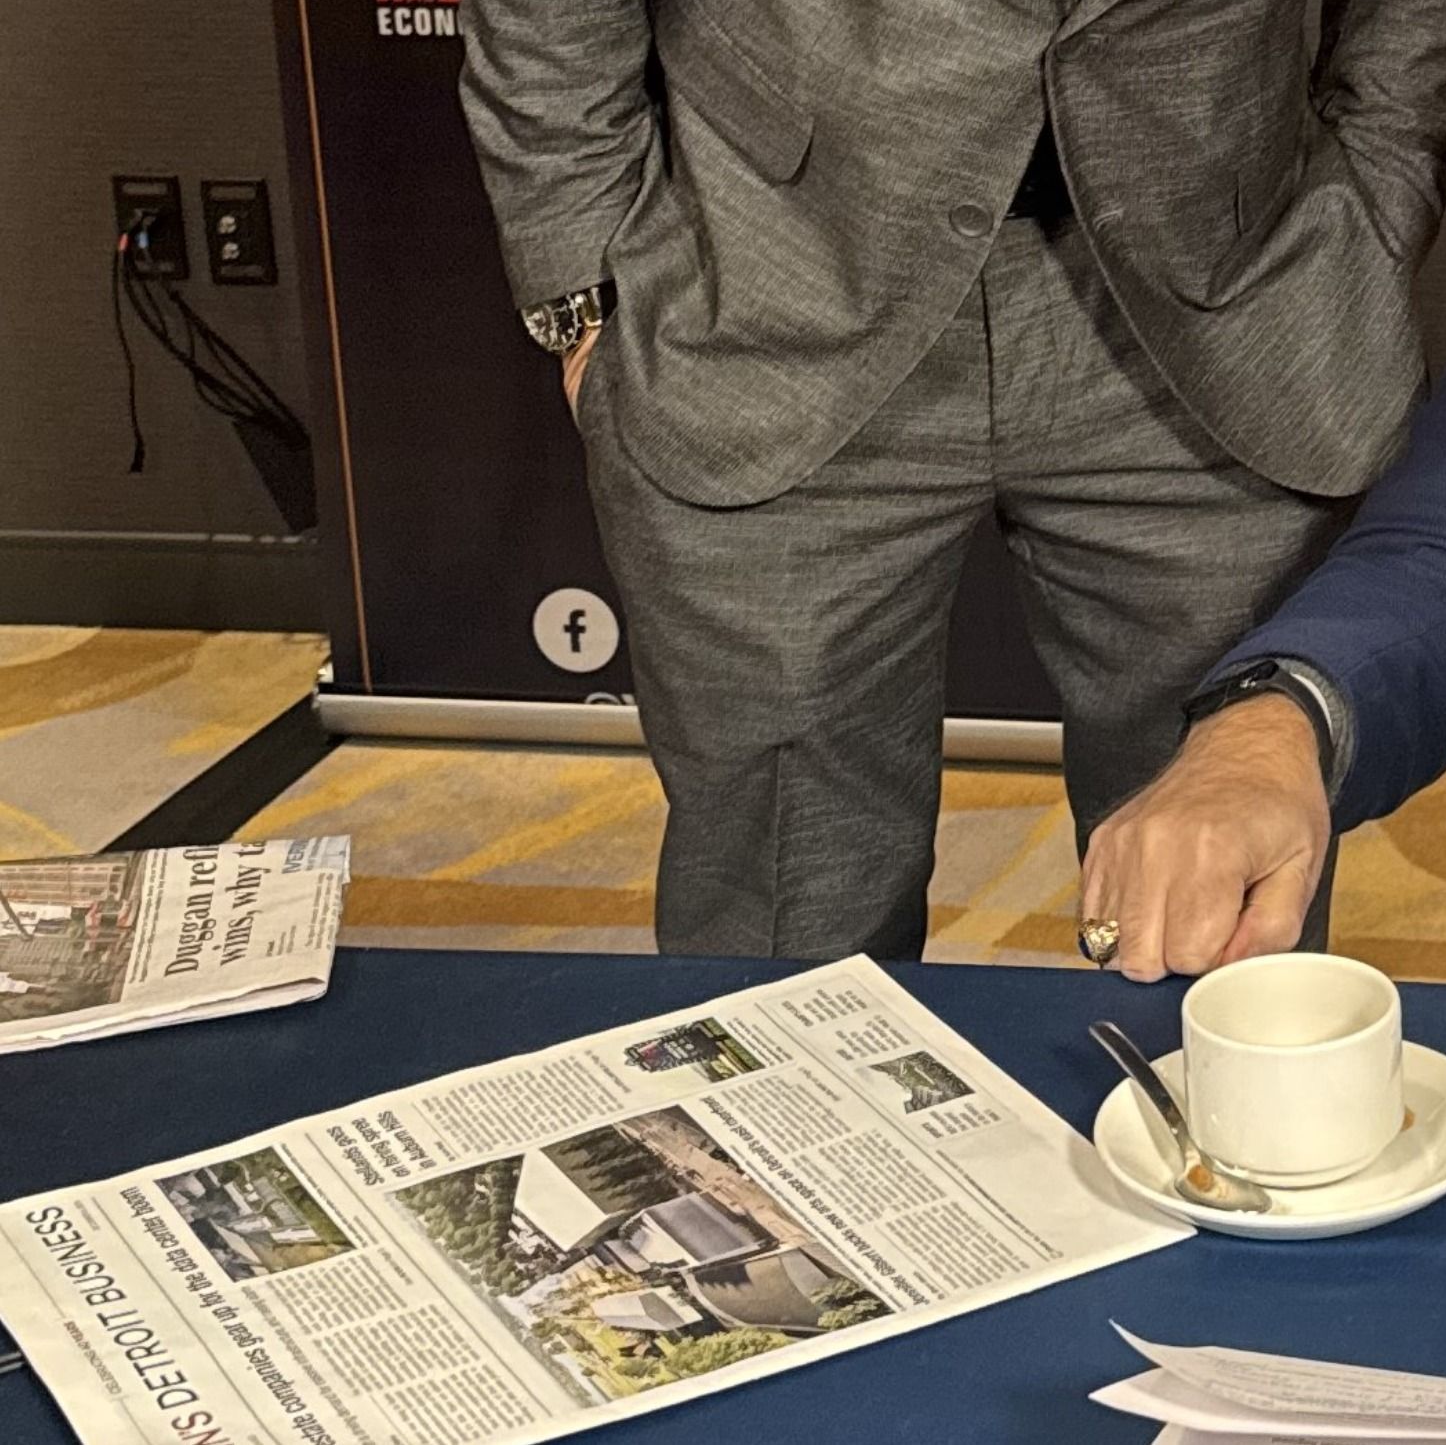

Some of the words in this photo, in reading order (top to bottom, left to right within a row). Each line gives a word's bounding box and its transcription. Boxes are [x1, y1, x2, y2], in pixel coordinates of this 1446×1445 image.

[225, 864, 272, 910] why
[164, 891, 218, 976] Duggan
[211, 909, 263, 967] wins,
[120, 1186, 146, 1218] boom
[143, 1211, 180, 1251] center
[26, 1204, 127, 1307] BUSINESS
[166, 1247, 199, 1274] data
[185, 1270, 213, 1294] the
[199, 1289, 227, 1309] for
[212, 1306, 241, 1327] up
[224, 1320, 264, 1350] gear
[97, 1308, 200, 1411] DETROIT
[244, 1345, 307, 1413] companies
